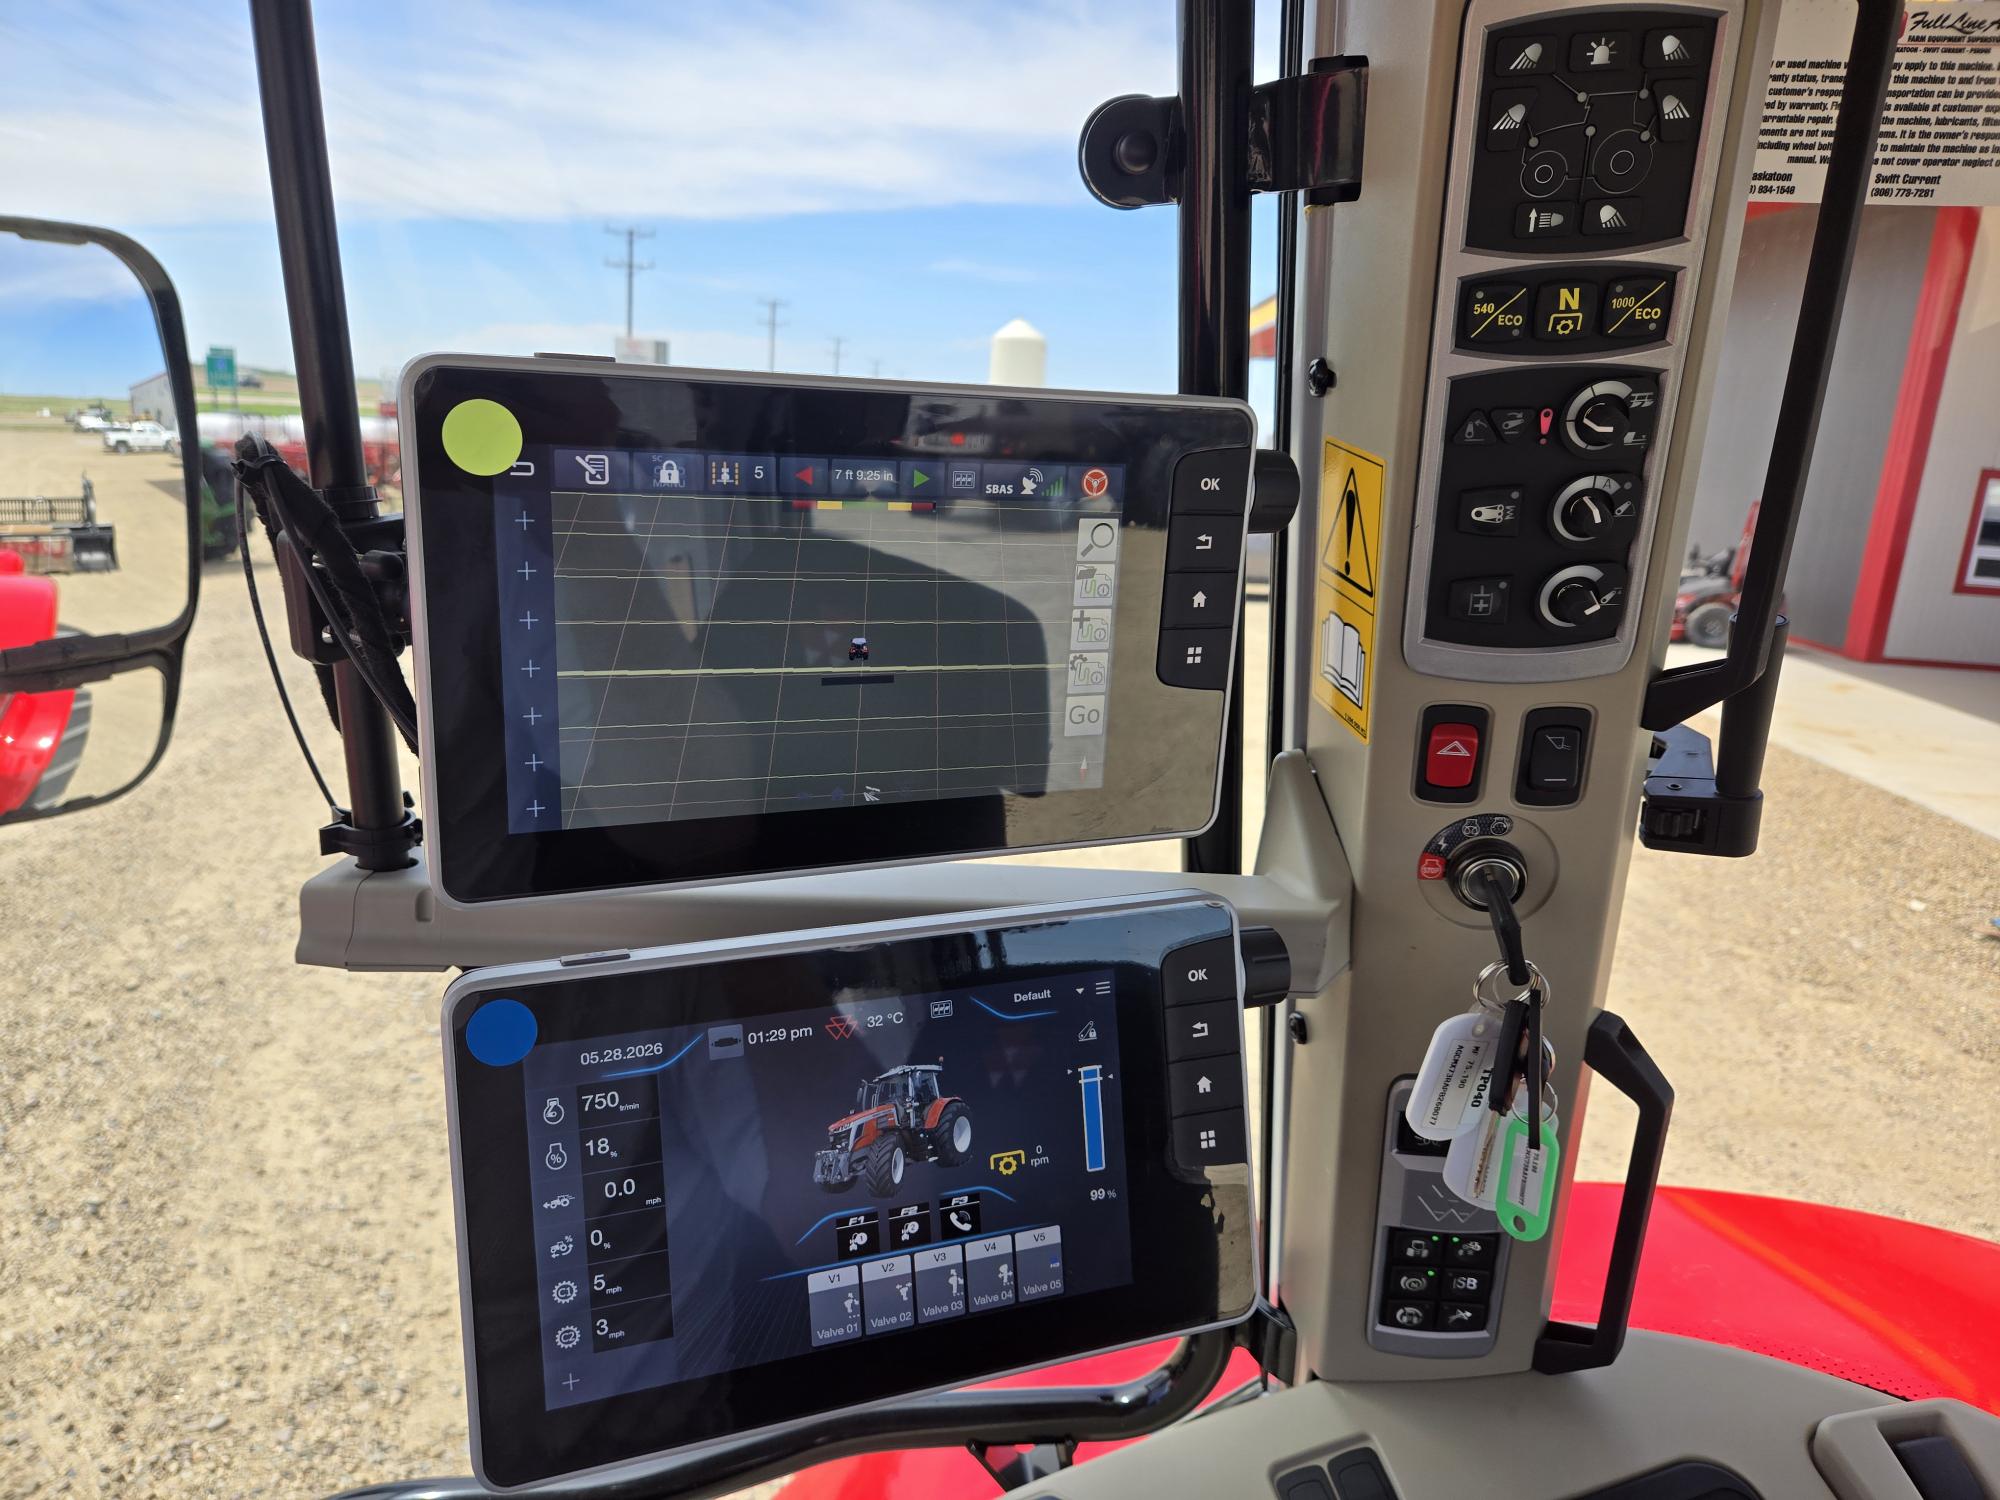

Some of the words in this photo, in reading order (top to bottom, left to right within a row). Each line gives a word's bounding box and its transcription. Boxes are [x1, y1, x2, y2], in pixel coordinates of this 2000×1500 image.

[1909, 11, 1952, 31] Full
[1946, 12, 1988, 34] Line
[1928, 35, 1966, 43] EQUIPMENT
[1776, 60, 1785, 69] or
[1787, 60, 1807, 69] used
[1808, 60, 1842, 69] machine
[1904, 60, 1927, 72] apply
[1929, 62, 1938, 70] to
[1940, 62, 1956, 71] this
[1791, 74, 1819, 84] status,
[1893, 74, 1909, 84] this
[1911, 76, 1946, 85] machine
[1948, 76, 1957, 84] to
[1958, 75, 1975, 85] and
[1976, 76, 1997, 85] from
[1768, 87, 1814, 96] customer's
[1937, 90, 1952, 98] can
[1954, 90, 1964, 98] be
[1777, 101, 1787, 111] by
[1789, 102, 1829, 112] warranty.
[1894, 102, 1930, 112] available
[1932, 103, 1941, 112] at
[1942, 104, 1983, 112] customer
[1806, 114, 1833, 125] repair.
[1882, 116, 1895, 125] the
[1896, 116, 1933, 127] machine,
[1934, 117, 1980, 128] lubricants,
[1790, 129, 1804, 137] are
[1806, 128, 1819, 137] not
[1909, 130, 1916, 139] is
[1918, 130, 1932, 139] the
[1934, 130, 1969, 140] owner's
[1792, 141, 1816, 151] wheel
[1880, 143, 1888, 152] to
[1890, 143, 1925, 153] maintain
[1927, 143, 1941, 153] the
[1942, 144, 1977, 153] machine
[1787, 155, 1817, 164] manual.
[1881, 157, 1894, 166] not
[1896, 158, 1920, 166] cover
[1922, 158, 1960, 168] operator
[1962, 158, 1994, 168] neglect
[1752, 171, 1793, 181] askatoon
[1875, 174, 1901, 184] Swift
[1902, 174, 1941, 185] Current
[1559, 288, 1580, 310] N
[1612, 296, 1635, 309] 1000
[1474, 303, 1495, 315] 540
[1635, 308, 1661, 320] ECO
[1498, 314, 1523, 326] ECO
[754, 466, 764, 479] 5
[834, 470, 841, 480] 7
[846, 469, 854, 480] ft
[856, 470, 881, 481] 9.25
[884, 470, 894, 481] in
[986, 484, 1014, 495] SBAS
[1200, 478, 1220, 491] OK
[1602, 478, 1612, 490] A
[1069, 705, 1100, 724] Go
[1188, 968, 1208, 982] OK
[1014, 988, 1051, 1003] Default
[867, 1015, 883, 1028] 32
[887, 1012, 904, 1025] °C
[748, 1028, 787, 1045] 01:29
[790, 1026, 813, 1042] pm
[580, 1042, 664, 1065] 05.28.2026
[1458, 1060, 1475, 1089] 75.190
[1471, 1067, 1493, 1108] TP040
[582, 1091, 620, 1112] 750
[585, 1138, 610, 1157] 18
[610, 1150, 618, 1159] %
[1036, 1145, 1043, 1155] 0
[1030, 1154, 1050, 1167] rpm
[604, 1178, 636, 1199] 0.0
[646, 1196, 662, 1207] mph
[1090, 1188, 1106, 1201] 99
[1107, 1189, 1117, 1199] %
[951, 1196, 969, 1207] F3
[848, 1216, 865, 1227] F1
[590, 1230, 603, 1247] 0
[604, 1242, 612, 1250] %
[1033, 1232, 1046, 1243] V5
[984, 1242, 997, 1253] V4
[933, 1252, 947, 1263] V3
[881, 1263, 895, 1273] V2
[594, 1274, 606, 1291] 5
[606, 1285, 623, 1295] mph
[828, 1274, 841, 1284] V1
[558, 1286, 572, 1299] C1
[1023, 1284, 1048, 1296] Valve
[1050, 1279, 1062, 1290] 05
[974, 1294, 999, 1307] Valve
[1001, 1289, 1013, 1300] 04
[923, 1304, 949, 1318] Valve
[950, 1300, 963, 1311] 03
[870, 1316, 897, 1329] Valve
[899, 1312, 912, 1322] 02
[596, 1318, 609, 1336] 3
[608, 1330, 625, 1340] mph
[817, 1328, 844, 1340] Valve
[846, 1323, 859, 1334] 01
[561, 1332, 576, 1344] C2
